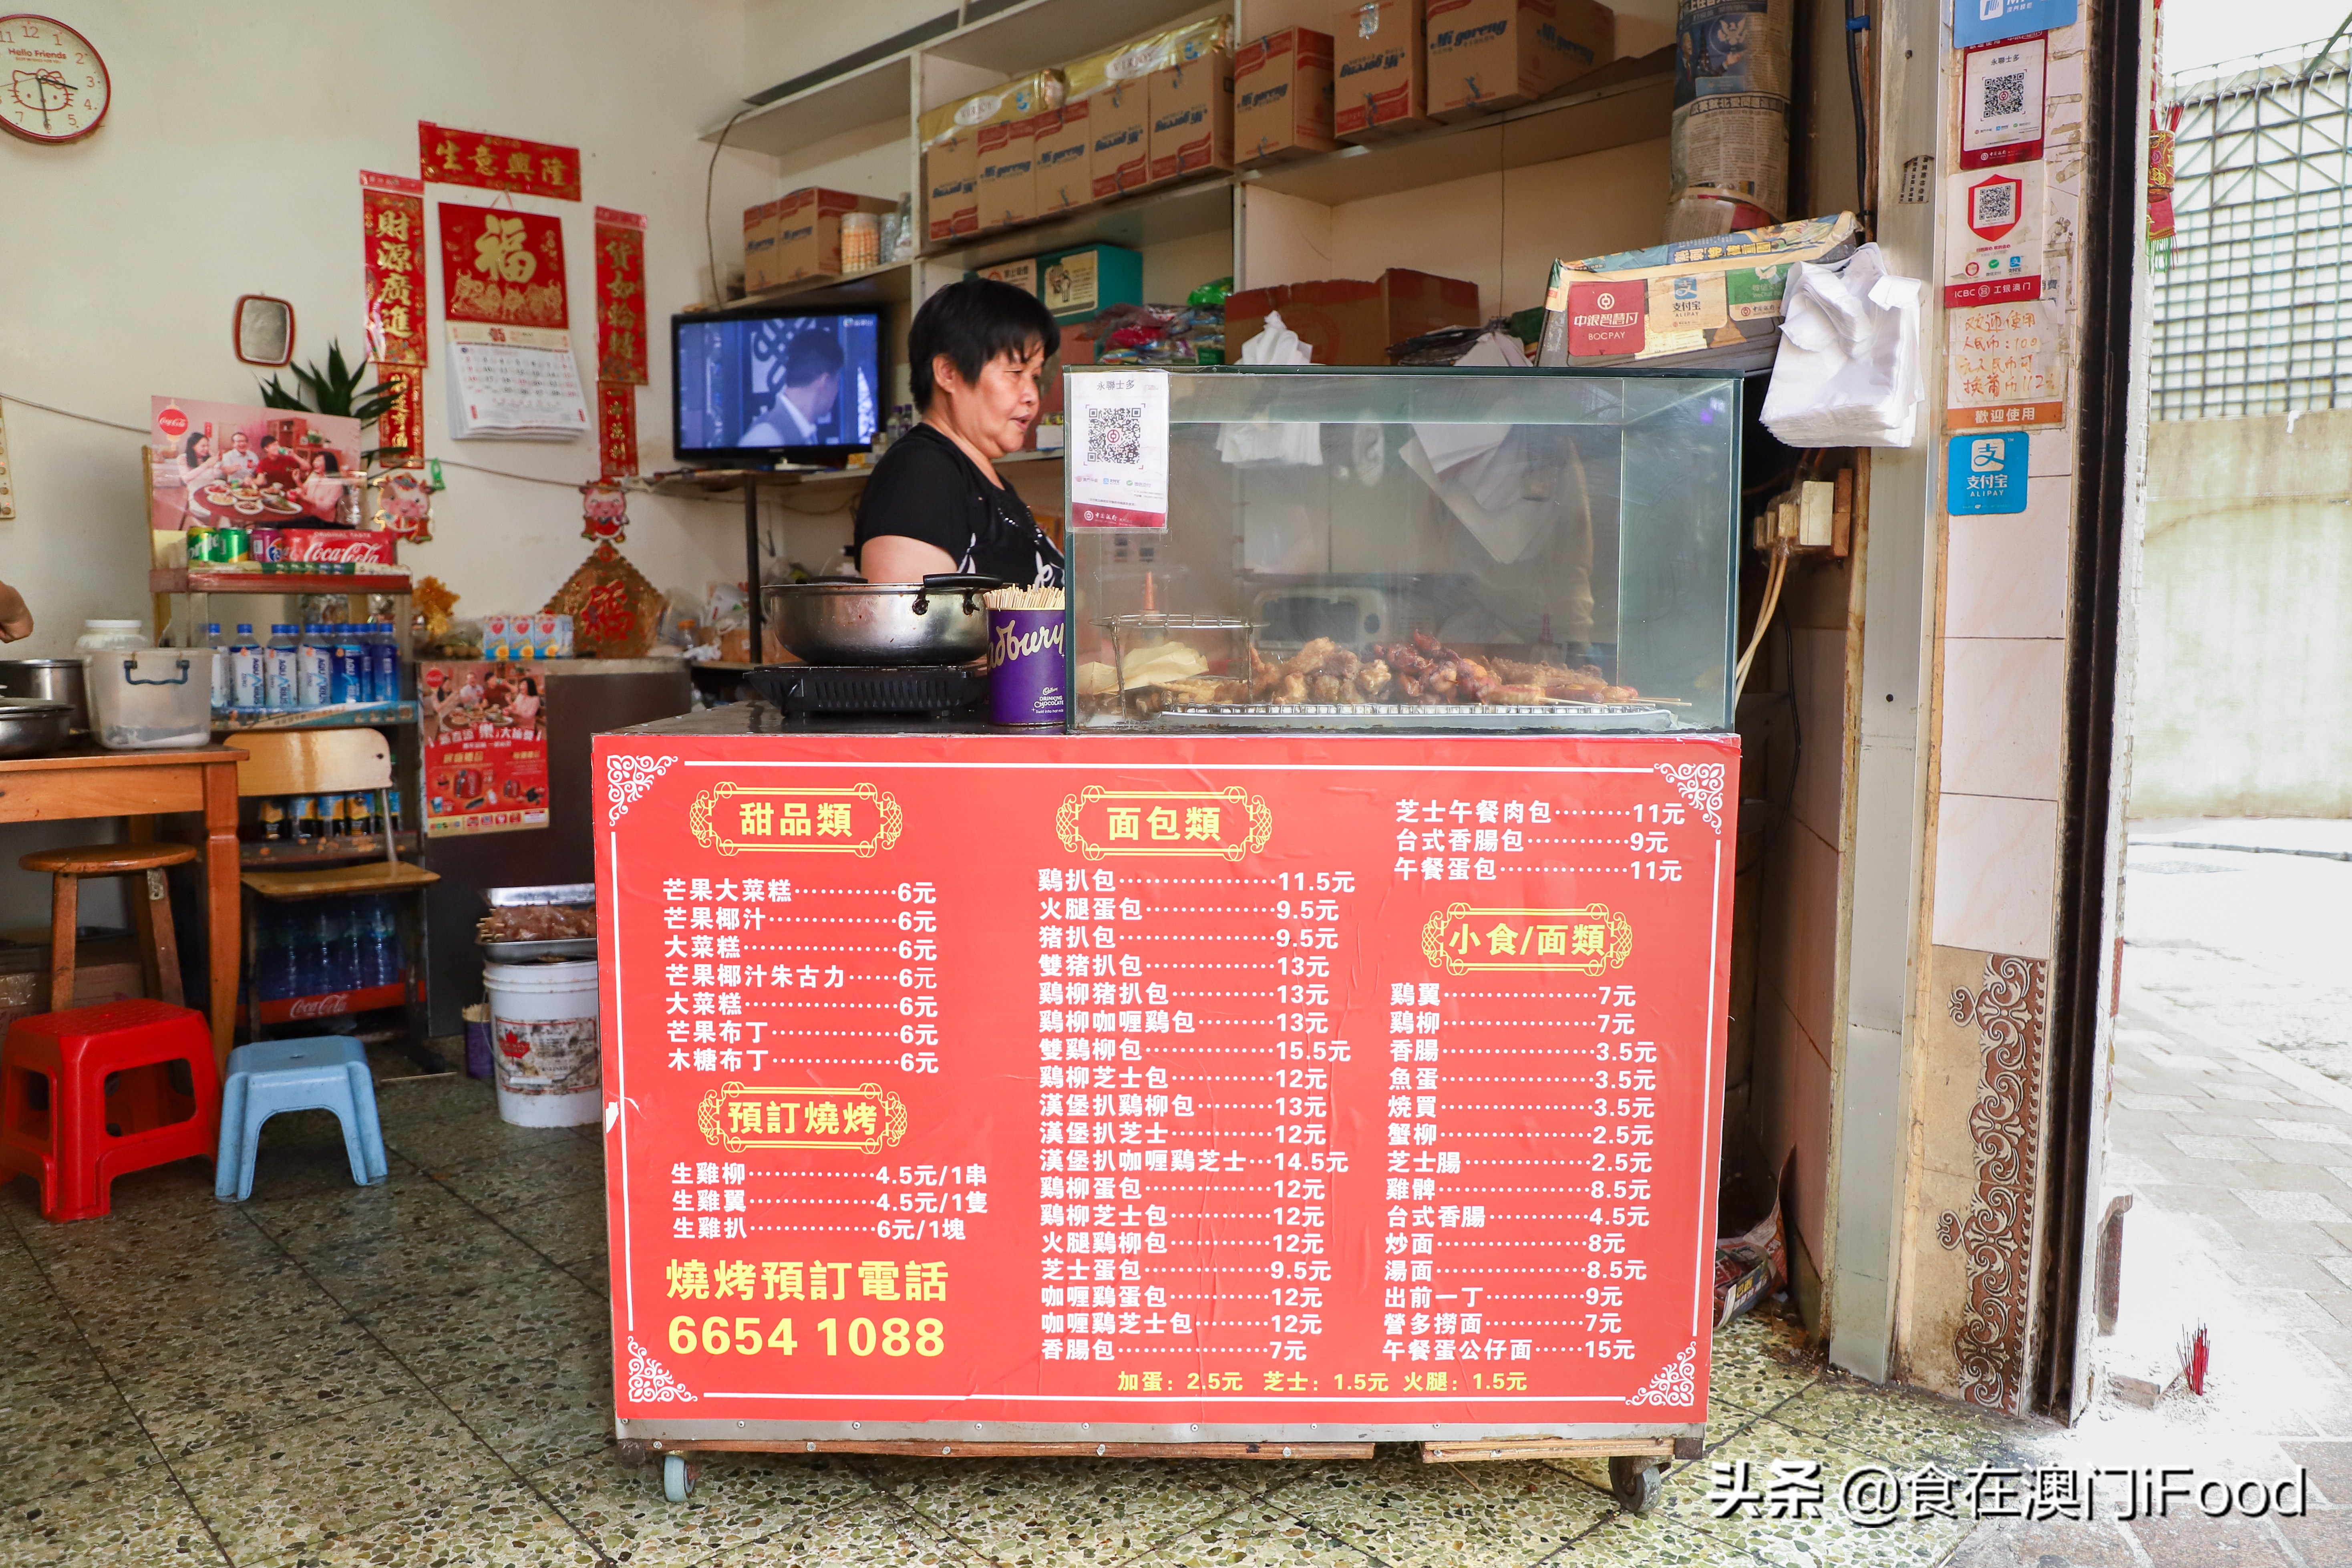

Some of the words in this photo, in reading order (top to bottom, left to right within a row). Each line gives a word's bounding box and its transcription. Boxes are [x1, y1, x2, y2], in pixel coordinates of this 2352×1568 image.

[22, 26, 39, 38] 12
[53, 34, 62, 45] 1
[8, 48, 32, 56] Hello
[35, 50, 67, 59] Friends
[75, 52, 84, 64] 2
[1991, 54, 2020, 66] 永聯士多
[86, 76, 95, 87] 3
[84, 99, 92, 110] 4
[15, 111, 23, 122] 7
[68, 114, 76, 125] 5
[436, 139, 567, 186] 生意興隆
[474, 214, 537, 283] 福
[376, 212, 413, 340] 財源廣進
[606, 241, 637, 359] 貨如輪轉
[1954, 289, 1975, 298] ICBC
[1673, 301, 1701, 312] 支付宝
[1574, 312, 1639, 327] 中銀智慧付
[1588, 332, 1626, 340] BOCPAY
[1097, 379, 1135, 391] 永聯士多
[1975, 407, 2035, 424] 歡迎使用
[1966, 474, 2008, 489] 支付宝
[1034, 700, 1064, 708] CHOCOLATE
[739, 802, 853, 837] 甜品類
[1107, 805, 1221, 841] 面包類
[1396, 799, 1551, 824] 芝士午餐肉包
[1633, 803, 1685, 825] 11元
[1396, 828, 1524, 852] 台式香腸包
[1630, 831, 1669, 853] 9元
[1394, 856, 1497, 881] 午餐蛋包
[1630, 860, 1682, 882] 11元
[663, 878, 792, 902] 芒果大菜糕
[897, 882, 937, 904] 6元
[1279, 871, 1355, 893] 11.5元
[664, 906, 766, 931] 芒果椰汁
[898, 910, 937, 933] 6元
[1039, 897, 1143, 920] 火腿蛋包
[1276, 899, 1339, 921] 9.5元
[664, 934, 741, 959] 大菜糕
[898, 939, 937, 961] 6元
[1276, 928, 1339, 950] 9.5元
[1449, 922, 1606, 956] 小食/面類
[665, 963, 844, 988] 芒果椰汁朱古力
[1278, 956, 1330, 978] 13元
[666, 991, 742, 1016] 大菜糕
[1277, 984, 1329, 1006] 13元
[1599, 985, 1636, 1007] 7元
[666, 1019, 768, 1044] 芒果布丁
[1277, 1012, 1329, 1035] 13元
[1598, 1013, 1635, 1035] 7元
[668, 1047, 769, 1072] 木糖布丁
[1276, 1040, 1351, 1062] 15.5元
[1389, 1039, 1439, 1062] 香腸
[1596, 1041, 1657, 1063] 3.5元
[1276, 1068, 1328, 1090] 12元
[1388, 1067, 1439, 1091] 魚蛋
[1595, 1069, 1656, 1091] 3.5元
[728, 1100, 877, 1135] 預訂燒烤
[1276, 1096, 1327, 1118] 13元
[1594, 1097, 1655, 1119] 3.5元
[1039, 1121, 1168, 1145] 漢堡扒芝士
[1275, 1124, 1327, 1145] 12元
[1387, 1122, 1437, 1146] 蟹柳
[1593, 1125, 1654, 1146] 2.5元
[1274, 1151, 1349, 1173] 14.5元
[1387, 1149, 1461, 1174] 芝士腸
[1591, 1152, 1652, 1173] 2.5元
[671, 1161, 745, 1185] 生雞柳
[875, 1163, 987, 1187] 4.5元/1串
[1274, 1179, 1326, 1200] 12元
[1591, 1179, 1651, 1200] 8.5元
[672, 1189, 746, 1212] 生雞翼
[876, 1190, 988, 1214] 4.5元/1隻
[672, 1216, 747, 1240] 生雞扒
[877, 1218, 966, 1240] 6元/1塊
[1387, 1205, 1486, 1228] 台式香腸
[1589, 1206, 1650, 1227] 4.5元
[1385, 1232, 1434, 1255] 炒面
[1588, 1233, 1626, 1254] 8元
[666, 1258, 949, 1302] 燒烤預訂電話
[1041, 1258, 1141, 1281] 芝士蛋包
[1270, 1260, 1332, 1282] 9.5元
[1384, 1260, 1433, 1282] 湯面
[1587, 1260, 1647, 1280] 8.5元
[1385, 1286, 1483, 1308] 出前一丁
[1585, 1286, 1623, 1307] 9元
[1384, 1312, 1483, 1335] 營多撈面
[1585, 1312, 1622, 1334] 7元
[668, 1315, 798, 1356] 6654
[817, 1317, 944, 1357] 1088
[1041, 1338, 1115, 1361] 香腸包
[1270, 1340, 1307, 1361] 7元
[1382, 1338, 1533, 1362] 午餐蛋公仔面
[1585, 1339, 1636, 1360] 15元
[1187, 1372, 1243, 1391] 2.5元
[1334, 1373, 1389, 1392] 1.5元
[1473, 1372, 1527, 1391] 1.5元
